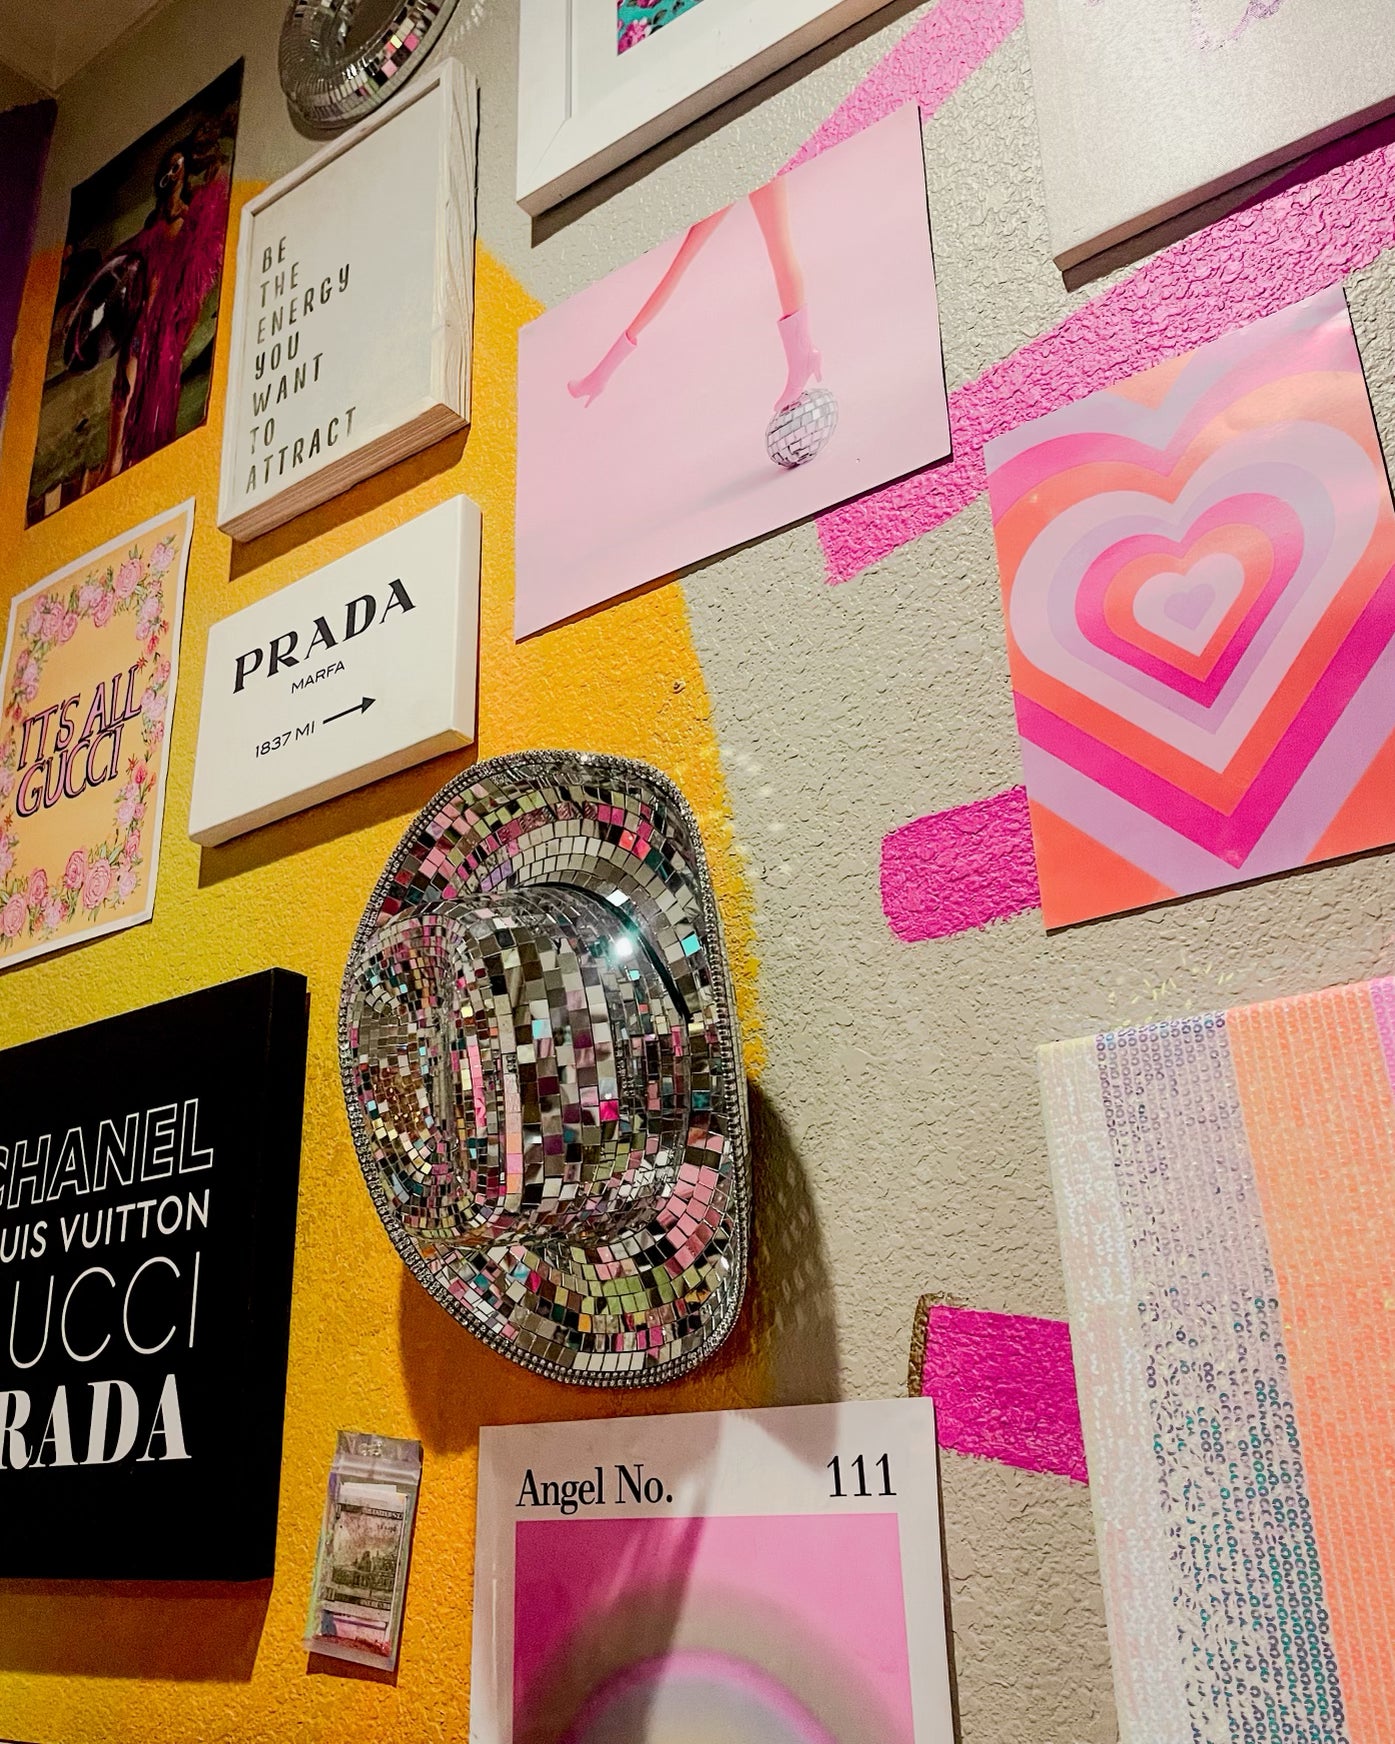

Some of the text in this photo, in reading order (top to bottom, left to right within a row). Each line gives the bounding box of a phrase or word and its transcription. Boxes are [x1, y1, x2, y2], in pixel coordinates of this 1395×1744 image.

[260, 261, 300, 308] THE
[262, 236, 287, 274] BE
[257, 263, 350, 345] ENERGY
[252, 353, 323, 417] WANT
[255, 331, 300, 380] YOU
[245, 406, 356, 494] ATTRACT
[250, 417, 275, 455] TO
[232, 578, 416, 694] PRADA
[291, 660, 345, 694] MARFA
[16, 663, 143, 771] IT'S ALL
[255, 720, 315, 758] 1837 MI
[16, 723, 125, 818] GUCCI
[60, 1188, 210, 1253] VUITTON
[515, 1453, 897, 1515] Angel No. 111
